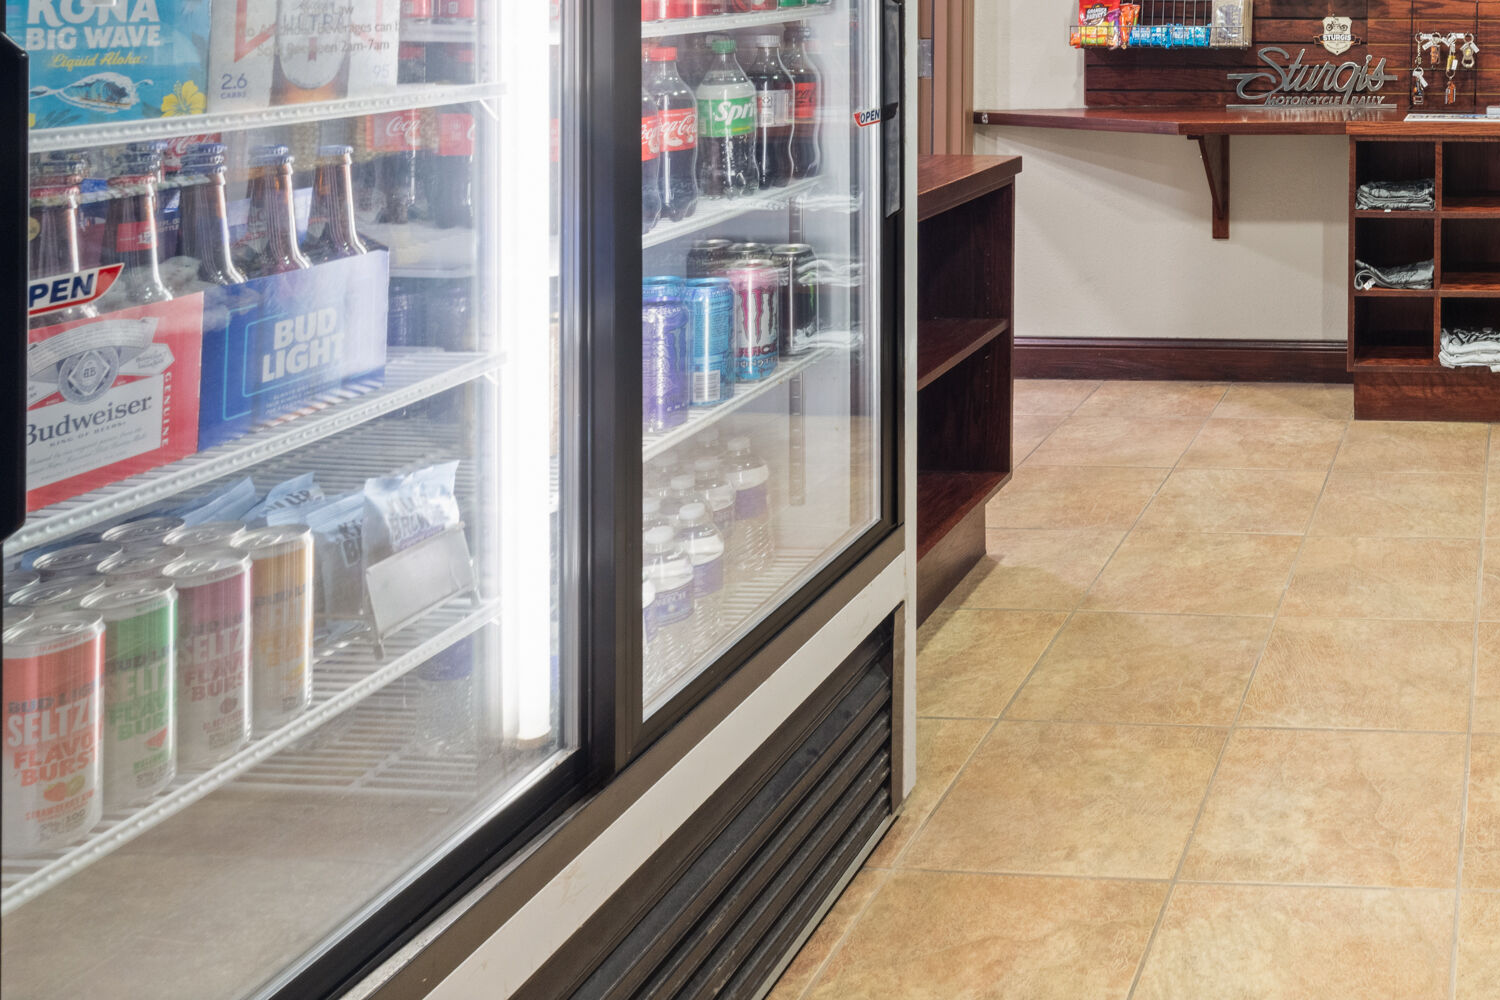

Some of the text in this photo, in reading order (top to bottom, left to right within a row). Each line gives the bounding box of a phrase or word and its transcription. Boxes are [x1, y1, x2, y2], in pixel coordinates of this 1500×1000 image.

[374, 22, 393, 34] can
[25, 25, 162, 51] BIG WAVE
[341, 39, 391, 53] 2am-7am
[1322, 33, 1352, 43] STURGIS
[48, 50, 143, 72] Liquid Aloha
[372, 64, 390, 79] 95
[1228, 47, 1398, 109] Sturgis
[220, 73, 248, 91] 2.6
[1265, 95, 1386, 106] MOTORCYCLE RALLY
[860, 110, 880, 125] OPEN
[274, 306, 338, 351] BUD
[262, 332, 346, 384] LIGHT
[160, 371, 174, 448] GENUINE
